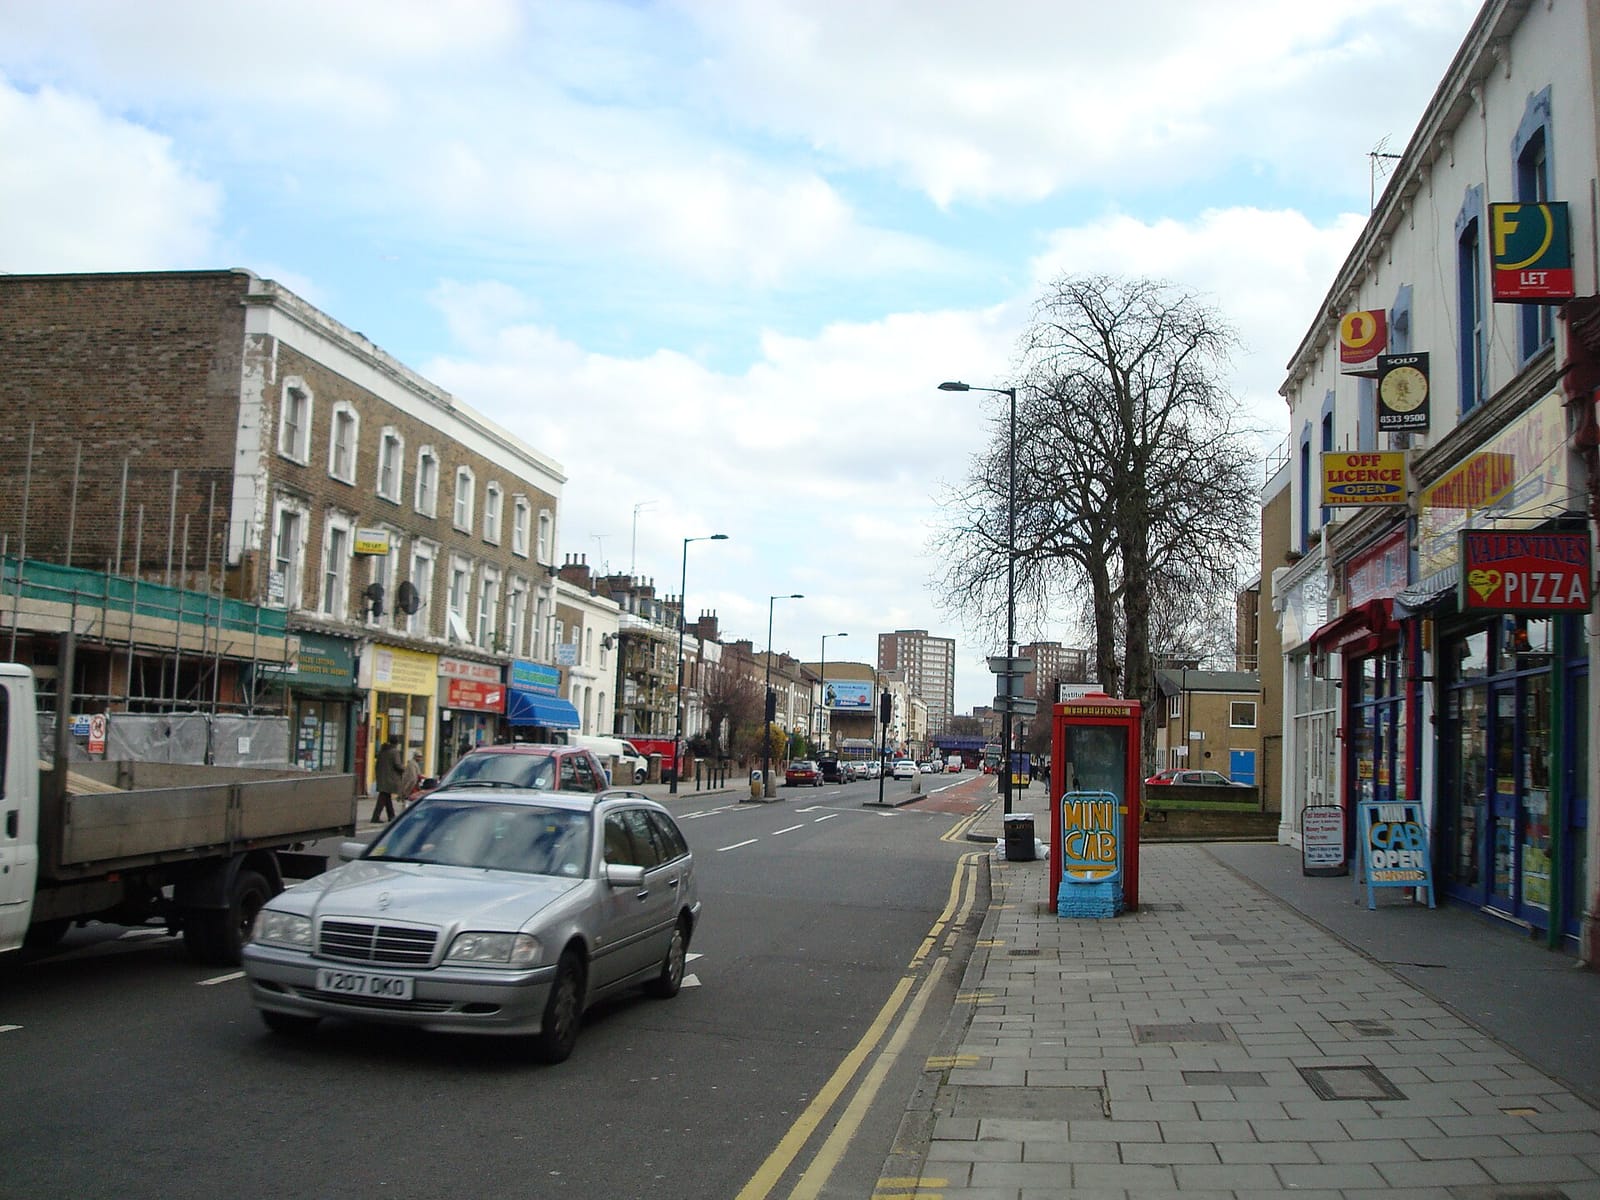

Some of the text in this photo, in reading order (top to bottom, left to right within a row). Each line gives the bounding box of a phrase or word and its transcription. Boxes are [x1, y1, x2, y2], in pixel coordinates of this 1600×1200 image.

[1520, 271, 1548, 285] LET
[1387, 357, 1418, 365] SOLD
[1380, 413, 1426, 424] 8533 9500
[1347, 455, 1381, 467] OFF
[1327, 469, 1401, 482] LICENCE
[1344, 485, 1387, 494] OPEN
[1364, 495, 1400, 503] LATE
[1468, 535, 1587, 567] VALENTINES
[1504, 572, 1587, 604] PIZZA
[1069, 706, 1128, 715] TELEPHONE
[1064, 800, 1113, 830] MINI
[1370, 821, 1425, 850] CAB
[1065, 830, 1117, 862] CAB
[1371, 849, 1425, 868] OPEN
